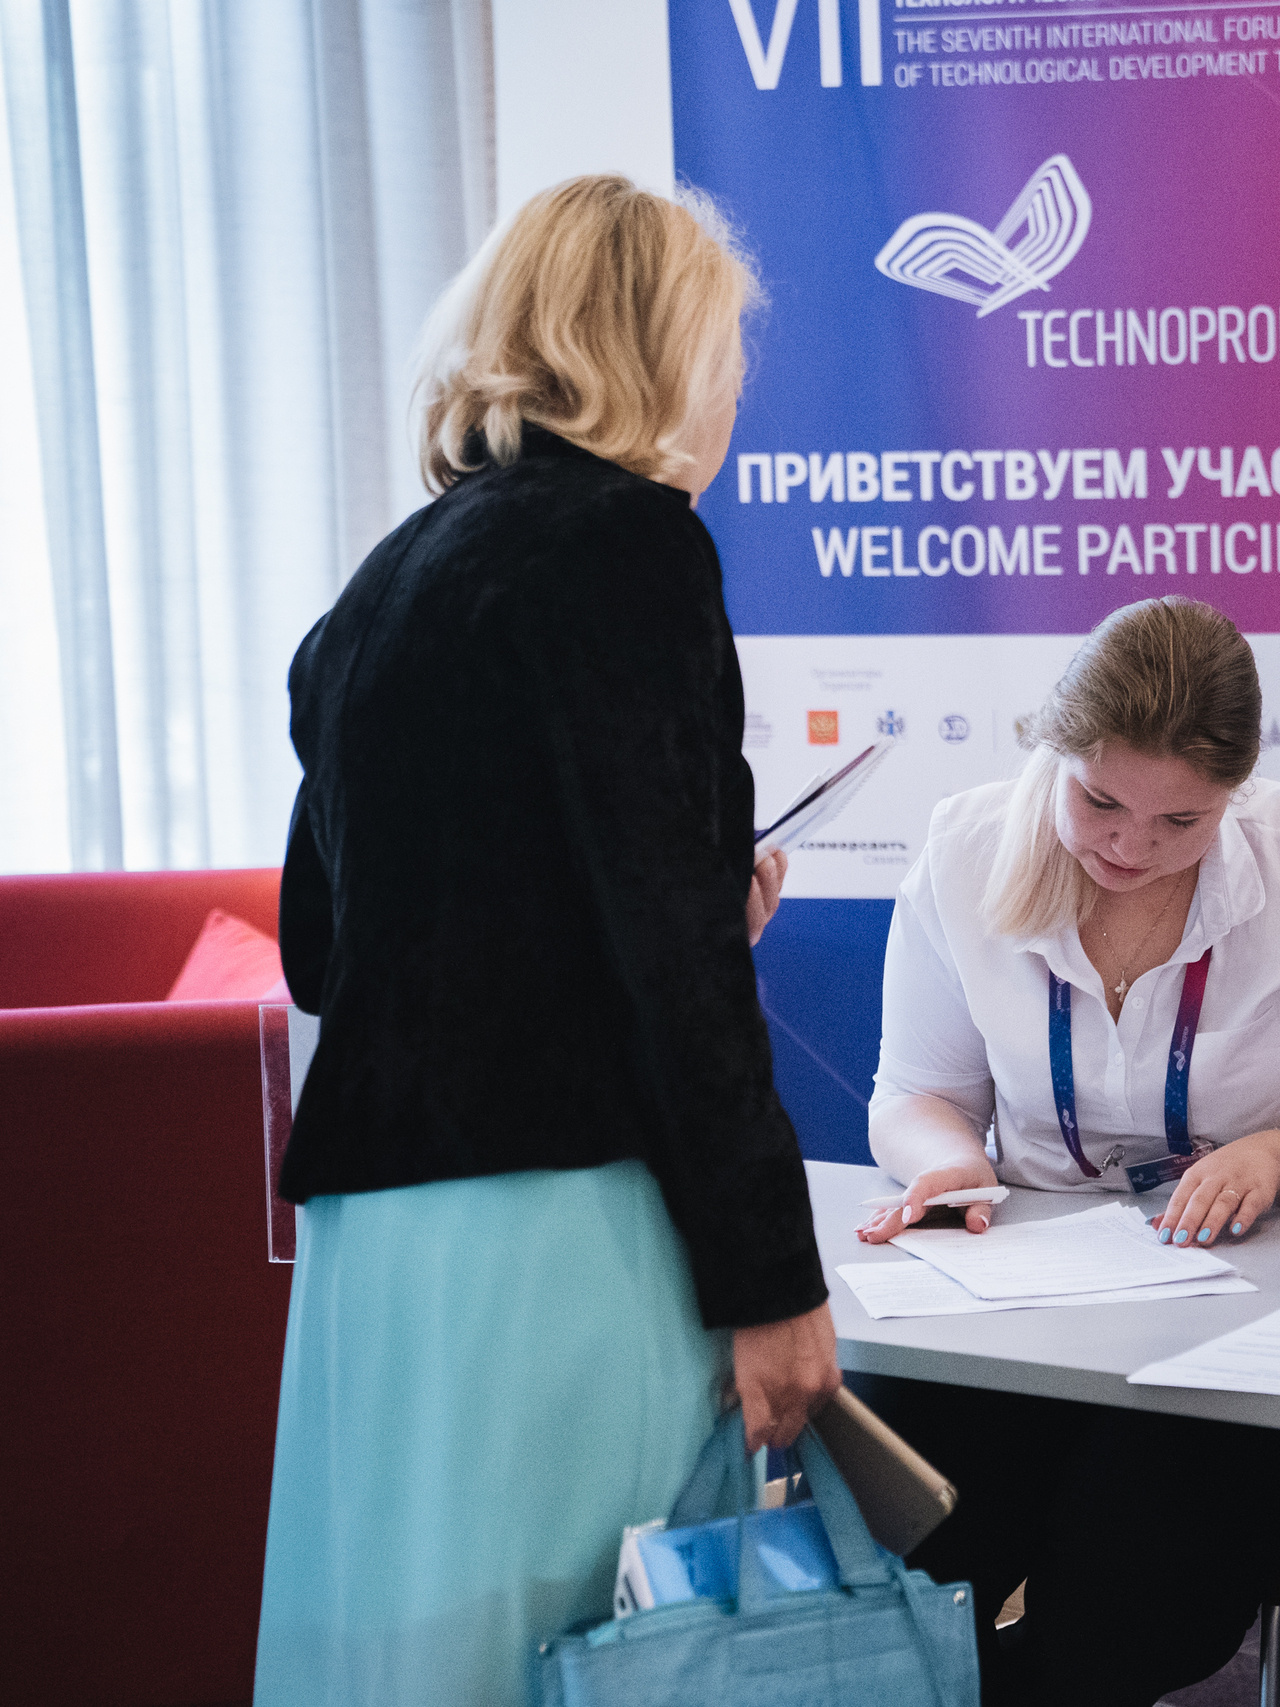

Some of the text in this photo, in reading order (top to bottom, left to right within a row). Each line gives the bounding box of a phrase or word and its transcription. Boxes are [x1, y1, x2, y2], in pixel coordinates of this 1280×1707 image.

[893, 28, 938, 53] THE
[941, 25, 1042, 52] SEVENTH
[1046, 20, 1218, 49] INTERNATIONAL
[893, 62, 924, 88] OF
[929, 58, 1105, 87] TECHNOLOGICAL
[1109, 52, 1269, 81] DEVELOPMENT
[736, 448, 1148, 504] ПРИВЕТСТВУЕМ
[811, 524, 1064, 578] WELCOME
